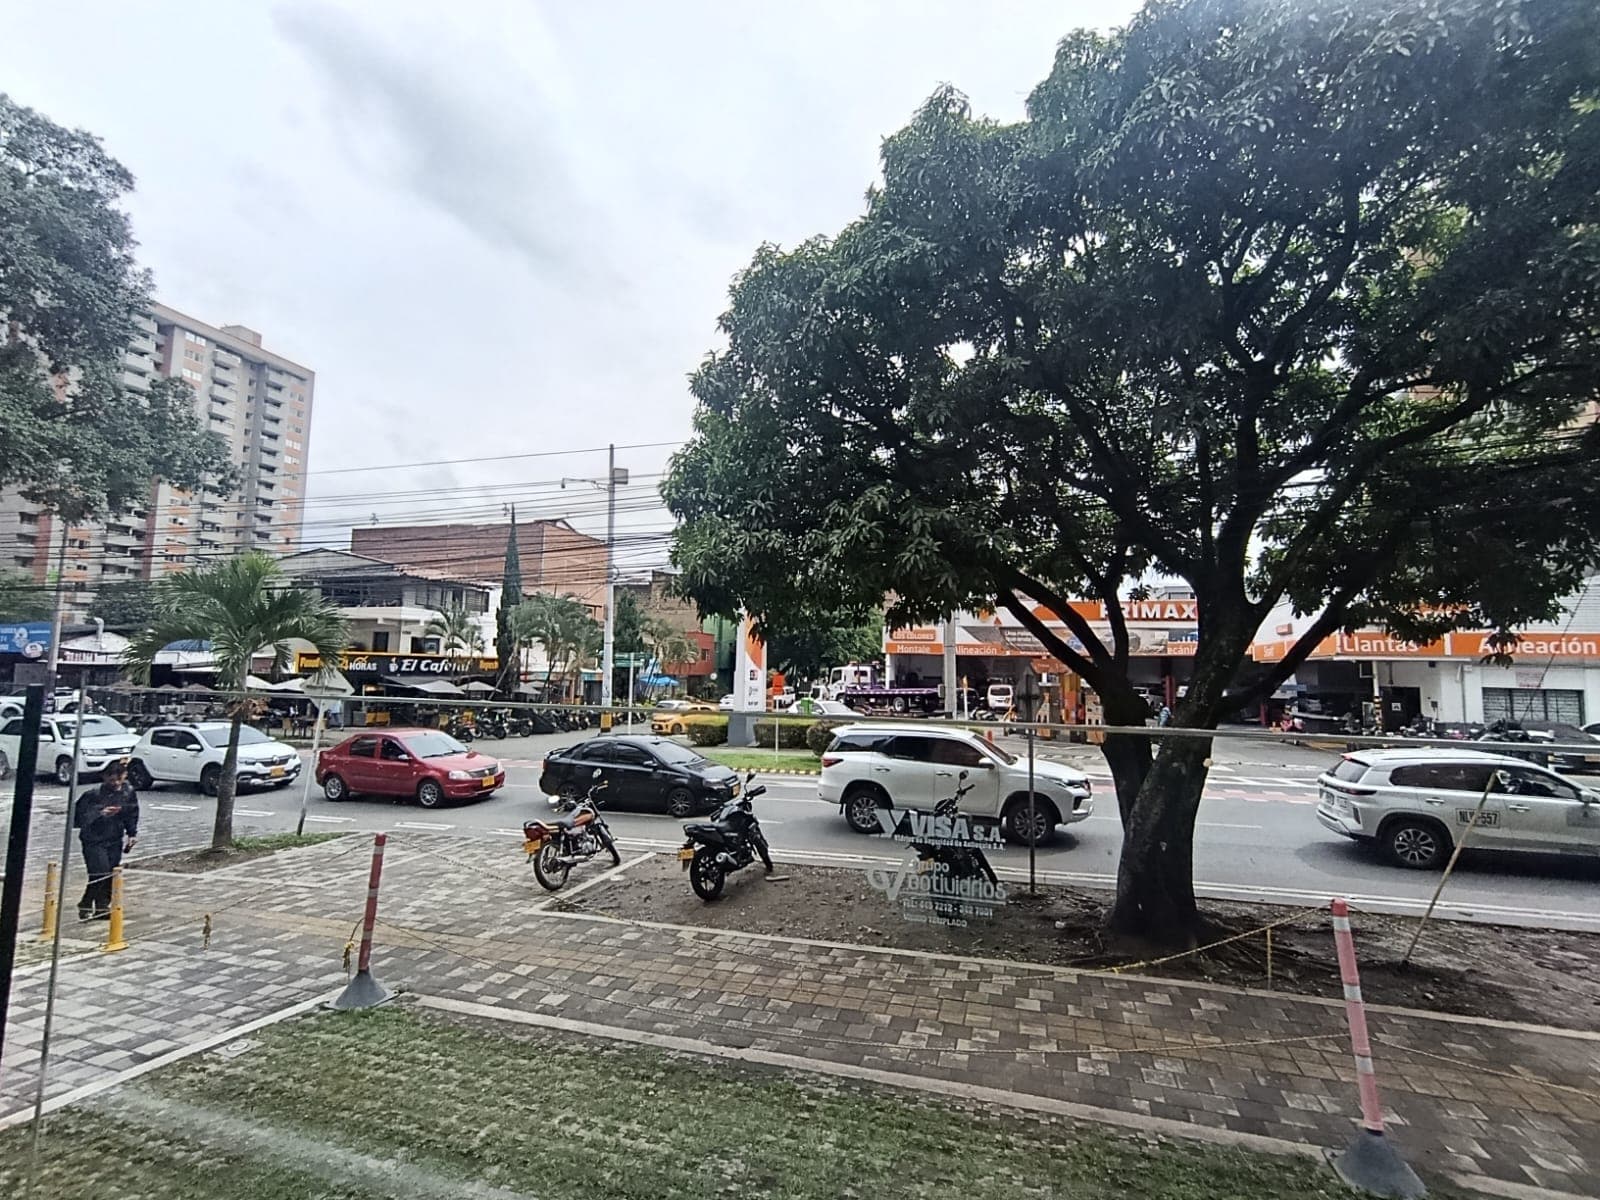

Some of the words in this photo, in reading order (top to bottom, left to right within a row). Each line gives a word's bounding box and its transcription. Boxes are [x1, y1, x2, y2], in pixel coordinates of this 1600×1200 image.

[401, 659, 418, 671] El
[909, 814, 970, 840] VISA
[973, 825, 1006, 843] S.A.
